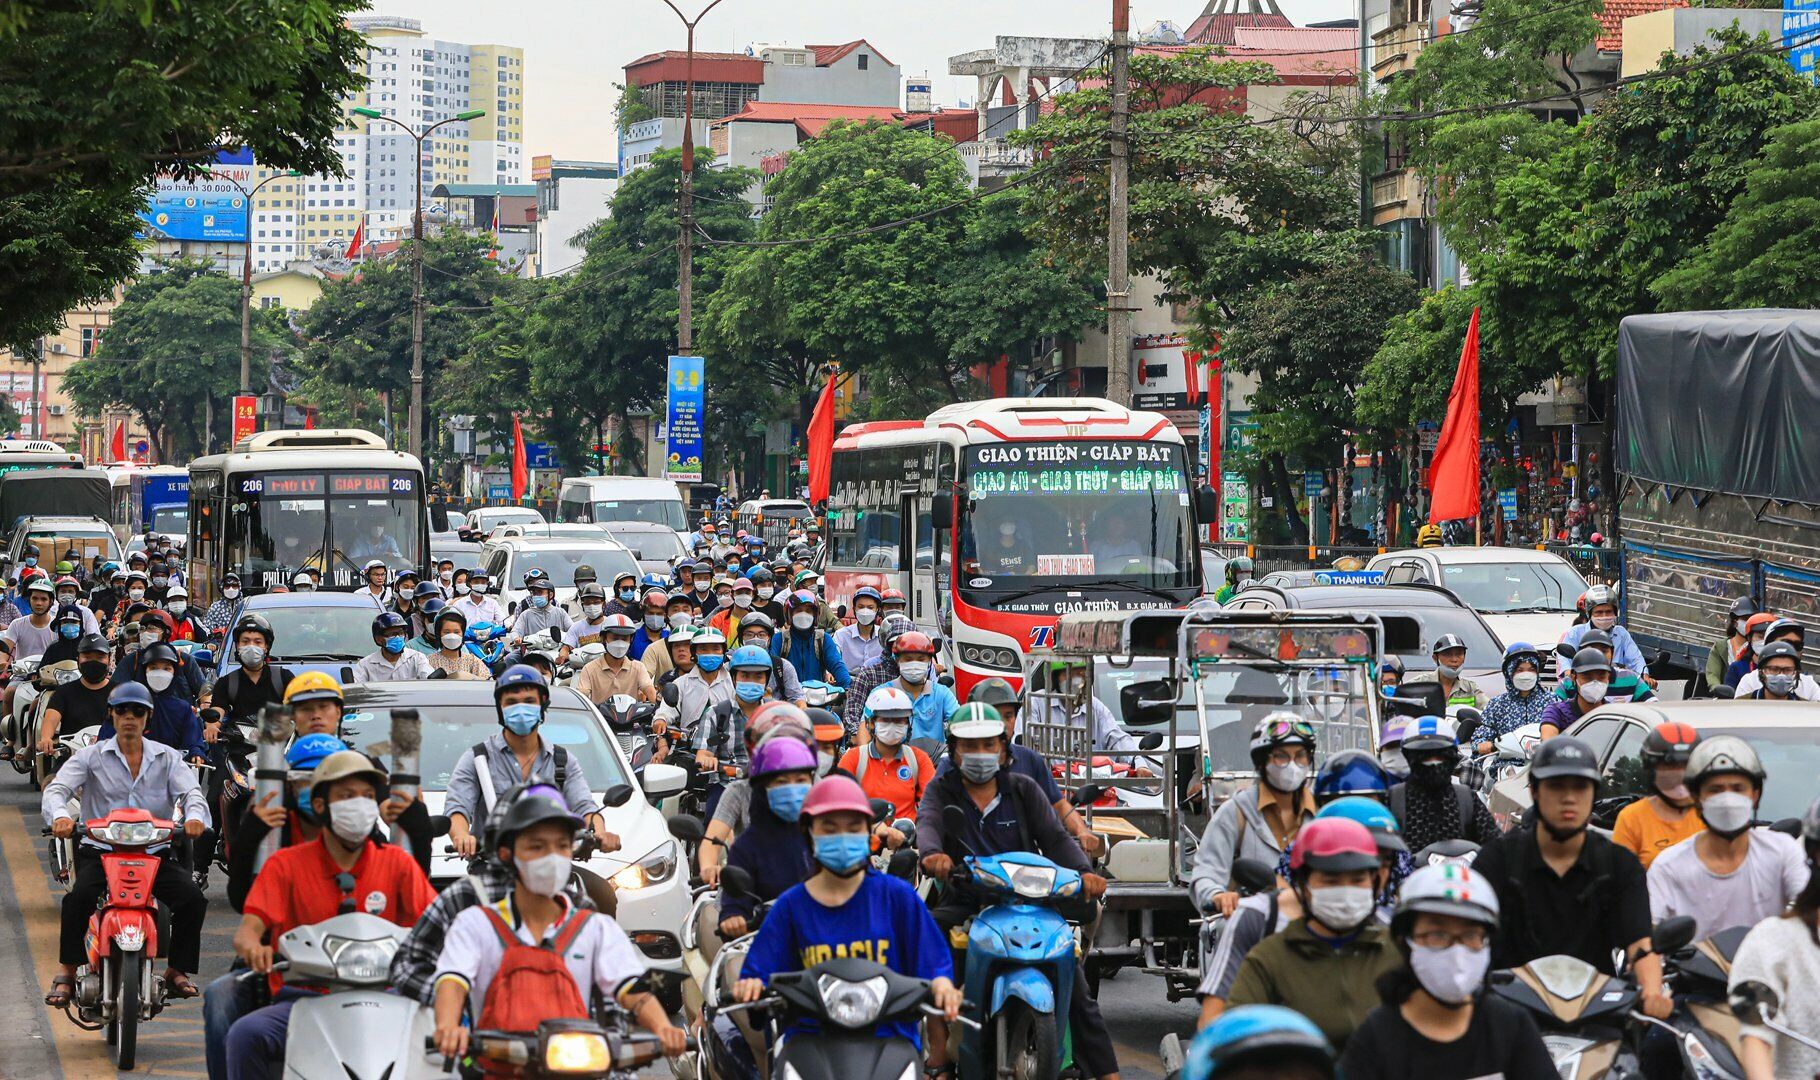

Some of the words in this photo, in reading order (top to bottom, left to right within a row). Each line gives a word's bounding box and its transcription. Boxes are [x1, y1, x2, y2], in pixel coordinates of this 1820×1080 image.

[175, 184, 198, 192] hành
[202, 184, 231, 193] 30.000
[1065, 425, 1088, 437] VIP
[978, 447, 1022, 463] GIAO
[1025, 443, 1078, 464] THIỆN
[1090, 443, 1133, 461] GIÁP
[1136, 443, 1171, 462] BÁT
[1040, 470, 1072, 491] GIAO
[1075, 465, 1109, 491] THỦY
[1120, 466, 1152, 491] GIÁP
[1155, 466, 1179, 490] BÁT
[168, 482, 177, 491] XE
[243, 480, 263, 492] 206
[392, 479, 412, 491] 206
[1000, 557, 1022, 566] SENSE
[333, 567, 351, 586] VĂN
[1332, 574, 1367, 585] THÀNH
[1368, 574, 1384, 586] LỢI
[1031, 602, 1050, 611] THỦY
[1054, 601, 1083, 614] GIAO
[1126, 602, 1139, 610] B.X
[1140, 601, 1157, 610] GIÁP
